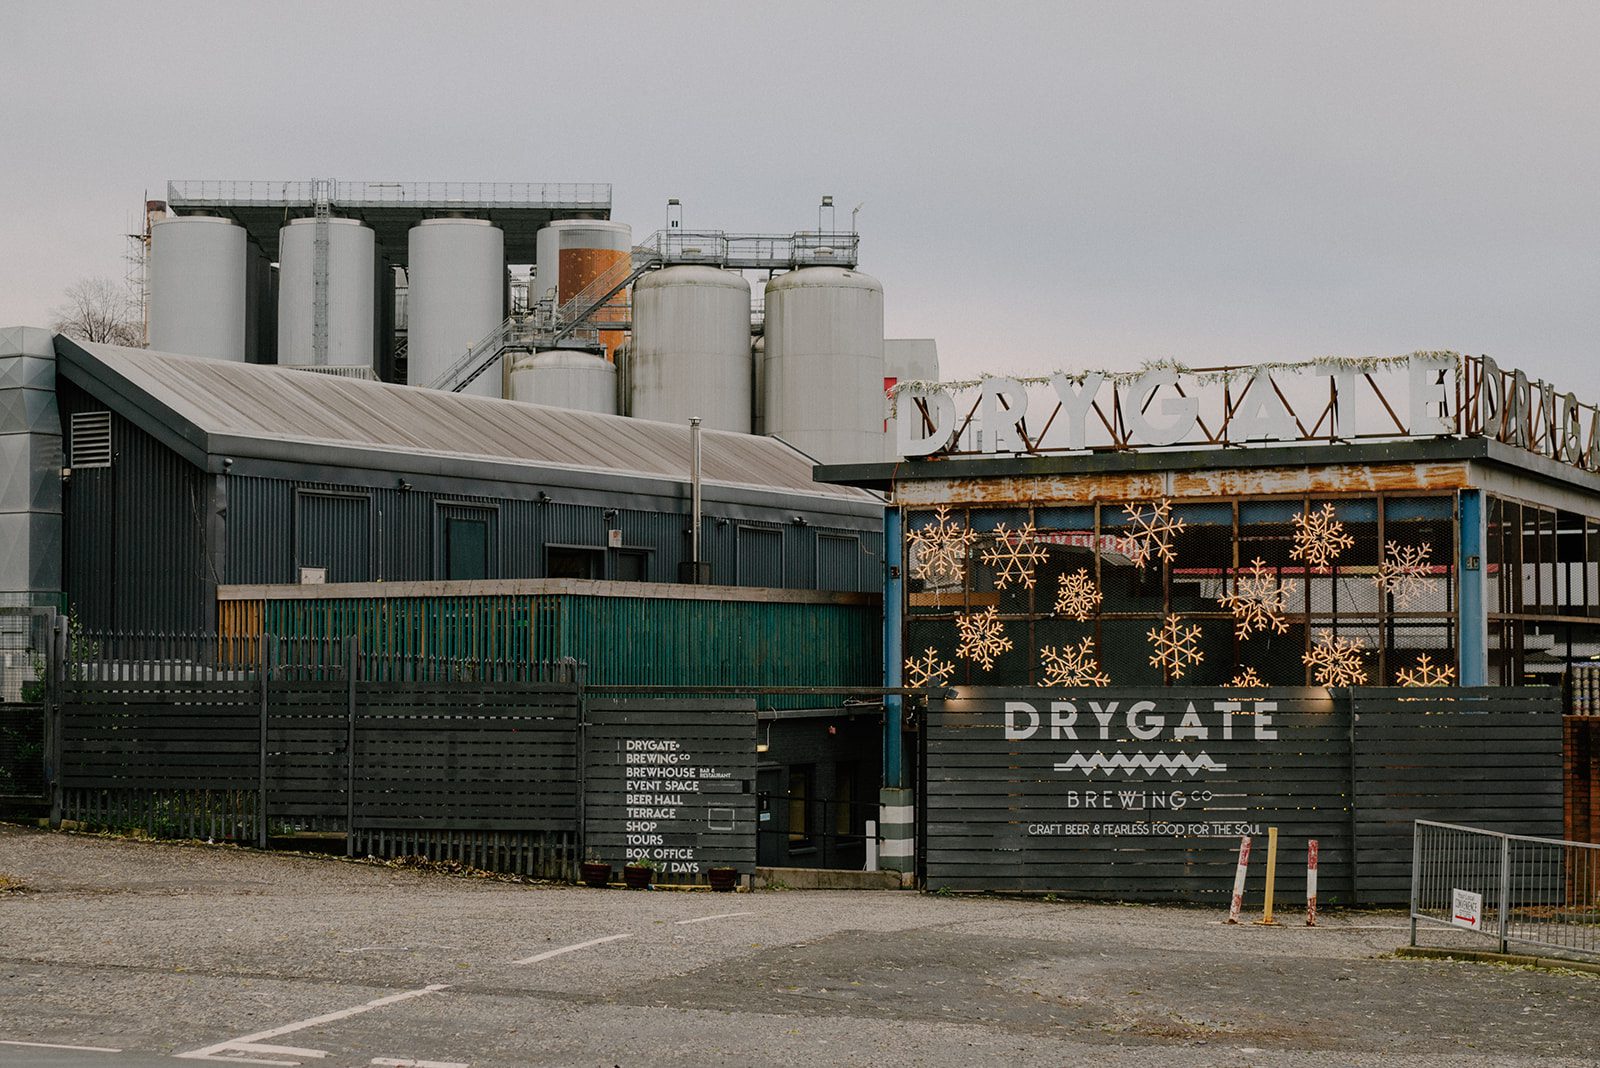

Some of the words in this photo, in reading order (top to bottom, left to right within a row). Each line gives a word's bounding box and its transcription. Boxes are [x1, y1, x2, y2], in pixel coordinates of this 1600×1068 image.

[897, 351, 1459, 456] DRYGATE
[1004, 701, 1278, 740] DRYGATE
[626, 740, 676, 751] DRYGATE
[626, 753, 678, 764] BREWING
[679, 753, 690, 761] CO
[626, 767, 696, 778] BREWHOUSE
[626, 781, 661, 791] EVENT
[665, 781, 699, 791] SPACE
[626, 794, 652, 805] BEER
[654, 795, 683, 805] HALL
[1067, 791, 1187, 808] BREWING
[1191, 790, 1213, 801] CO
[626, 808, 676, 819] TERRACE
[626, 822, 657, 832] SHOP
[1028, 824, 1062, 836] CRAFT
[1065, 824, 1090, 836] BEER
[1092, 824, 1100, 836] &
[1102, 824, 1149, 836] FEARLESS
[1152, 824, 1185, 836] FOOD
[1188, 824, 1210, 836] FOR
[1212, 824, 1232, 836] THE
[1234, 824, 1262, 836] SOUL
[626, 834, 663, 845] TOURS
[626, 848, 650, 859] BOX
[653, 849, 693, 859] OFFICE
[671, 862, 699, 873] DAYS
